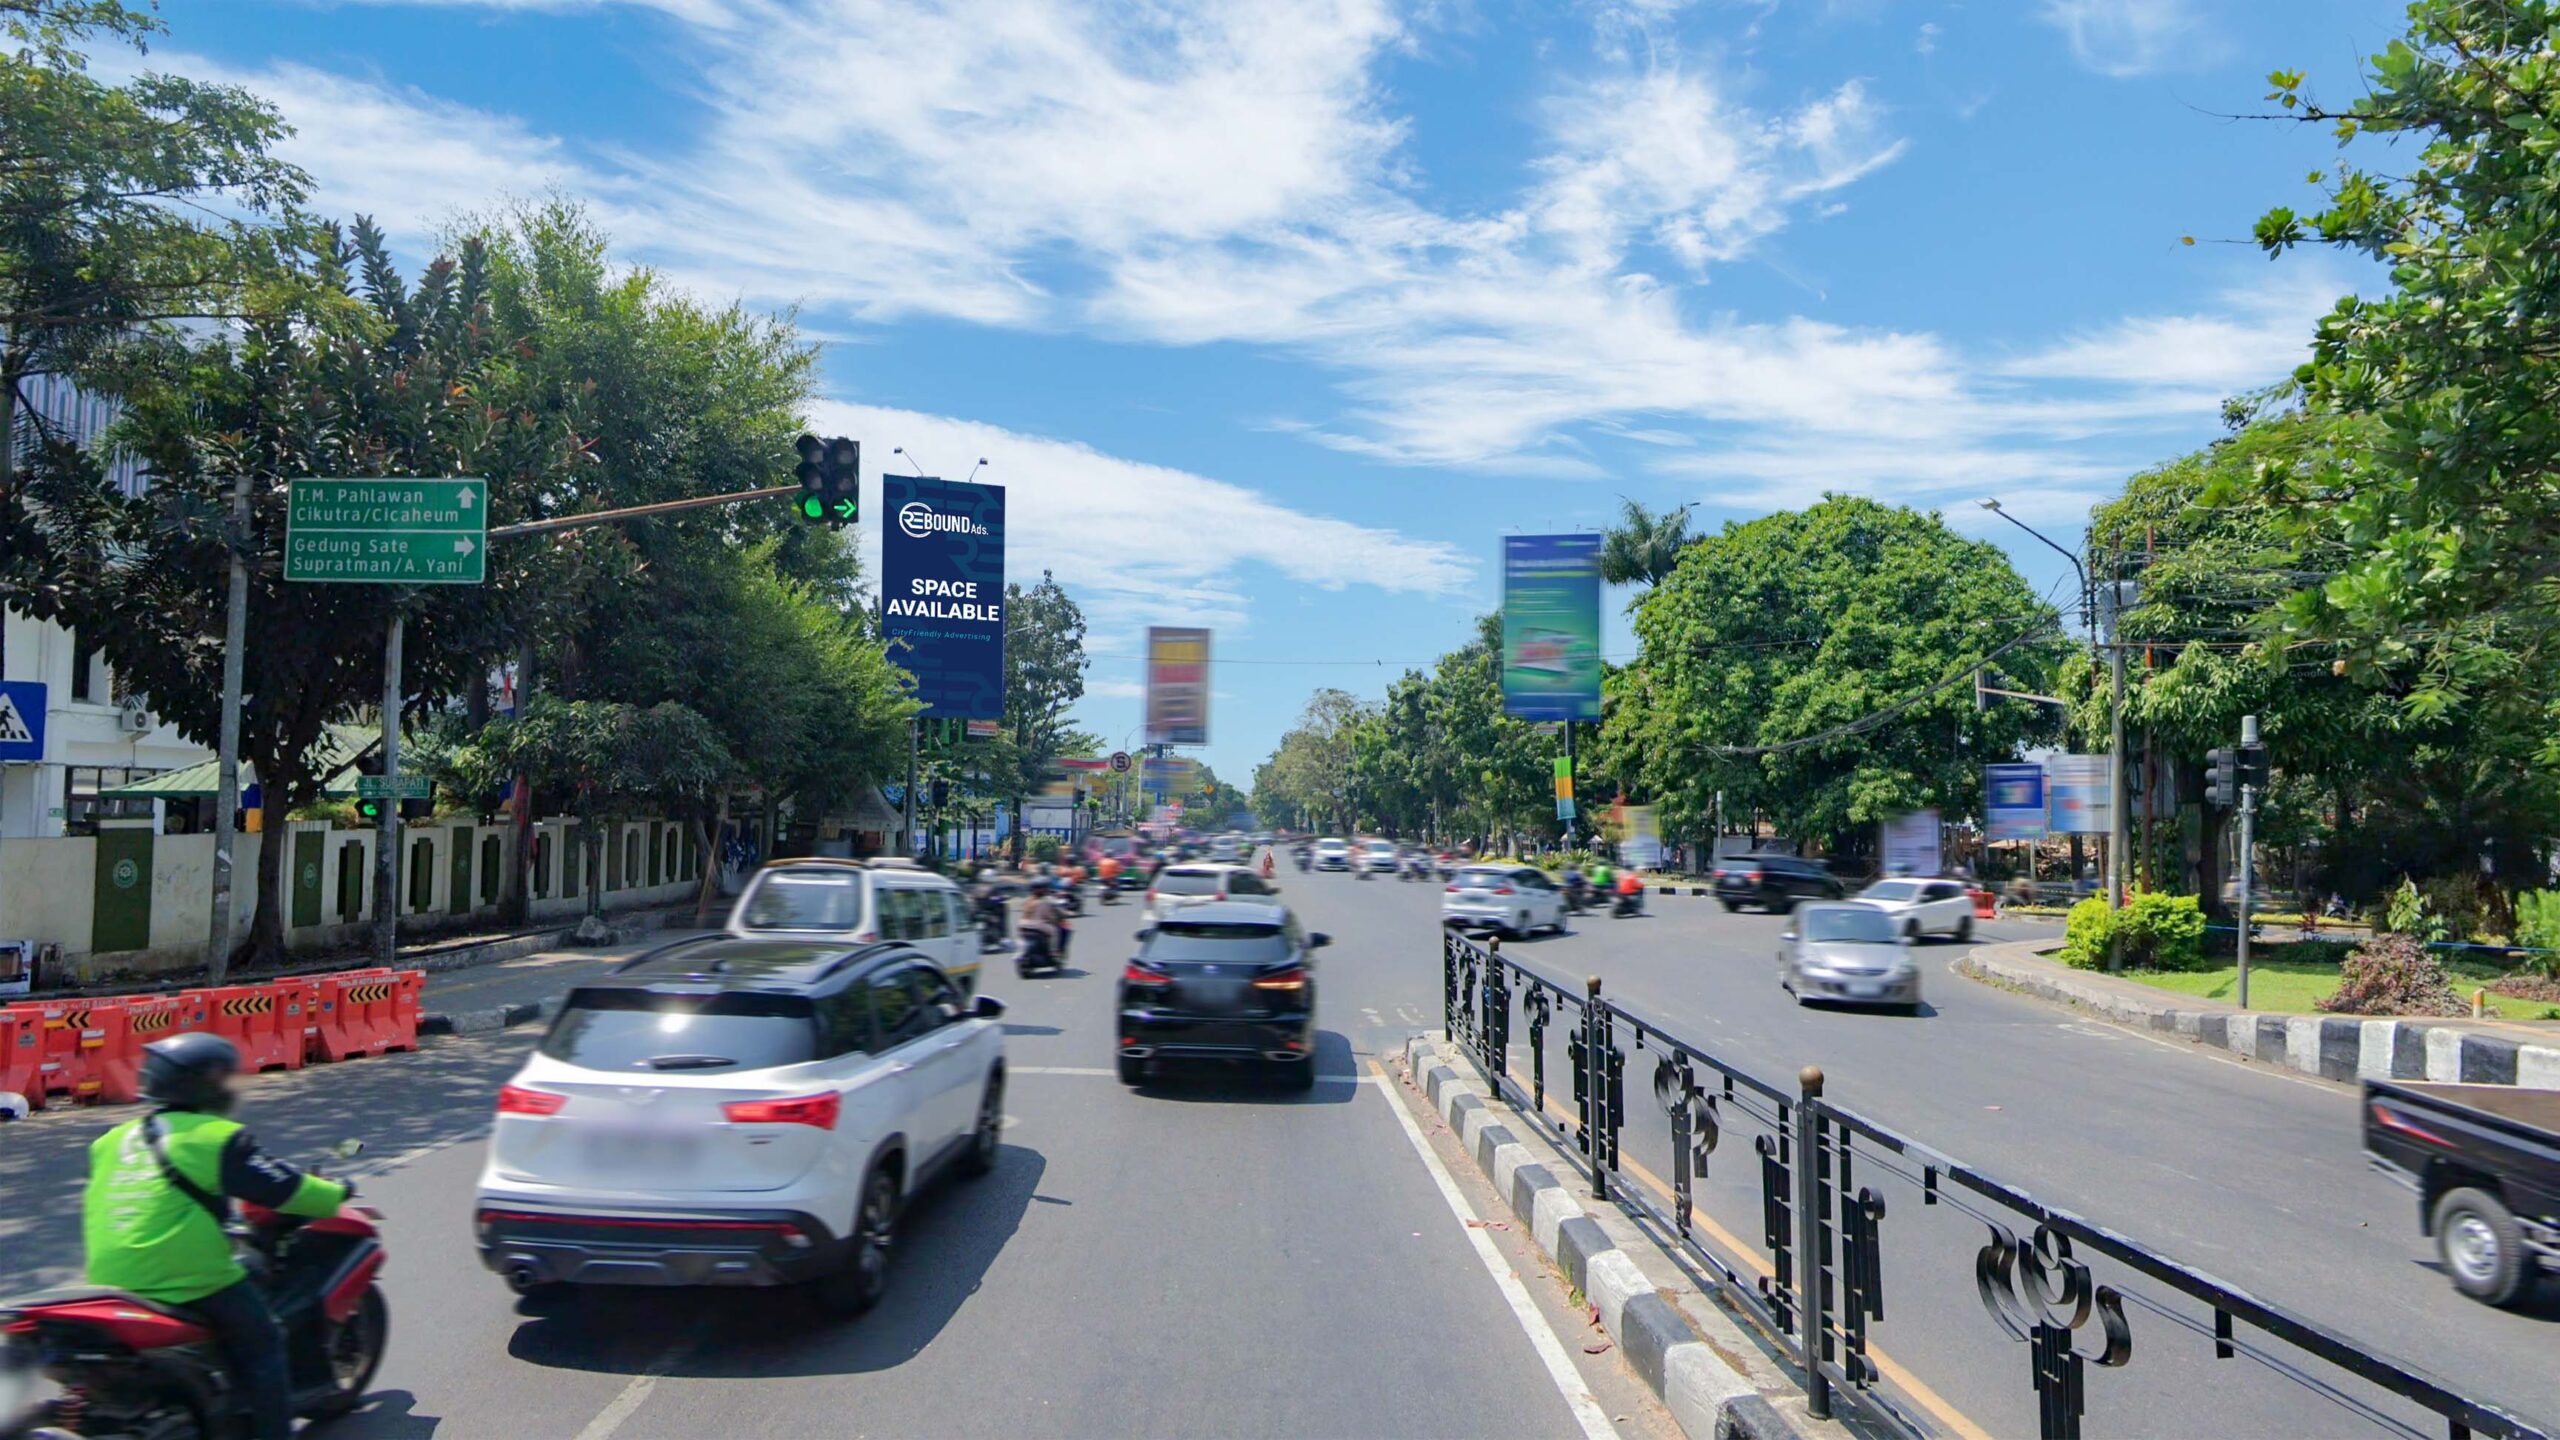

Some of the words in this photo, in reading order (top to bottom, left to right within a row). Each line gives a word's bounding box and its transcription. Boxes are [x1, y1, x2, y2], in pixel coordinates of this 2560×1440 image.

[298, 488, 330, 504] T.M.
[338, 488, 424, 504] Pahlawan
[296, 507, 459, 523] Cikutra/Cicaheum
[970, 525, 989, 536] Ads.
[295, 538, 360, 556] Gedung
[369, 540, 408, 554] Sate
[427, 558, 463, 573] Yani
[911, 578, 977, 598] SPACE
[887, 599, 999, 621] AVAILABLE
[945, 631, 991, 642] Advertising
